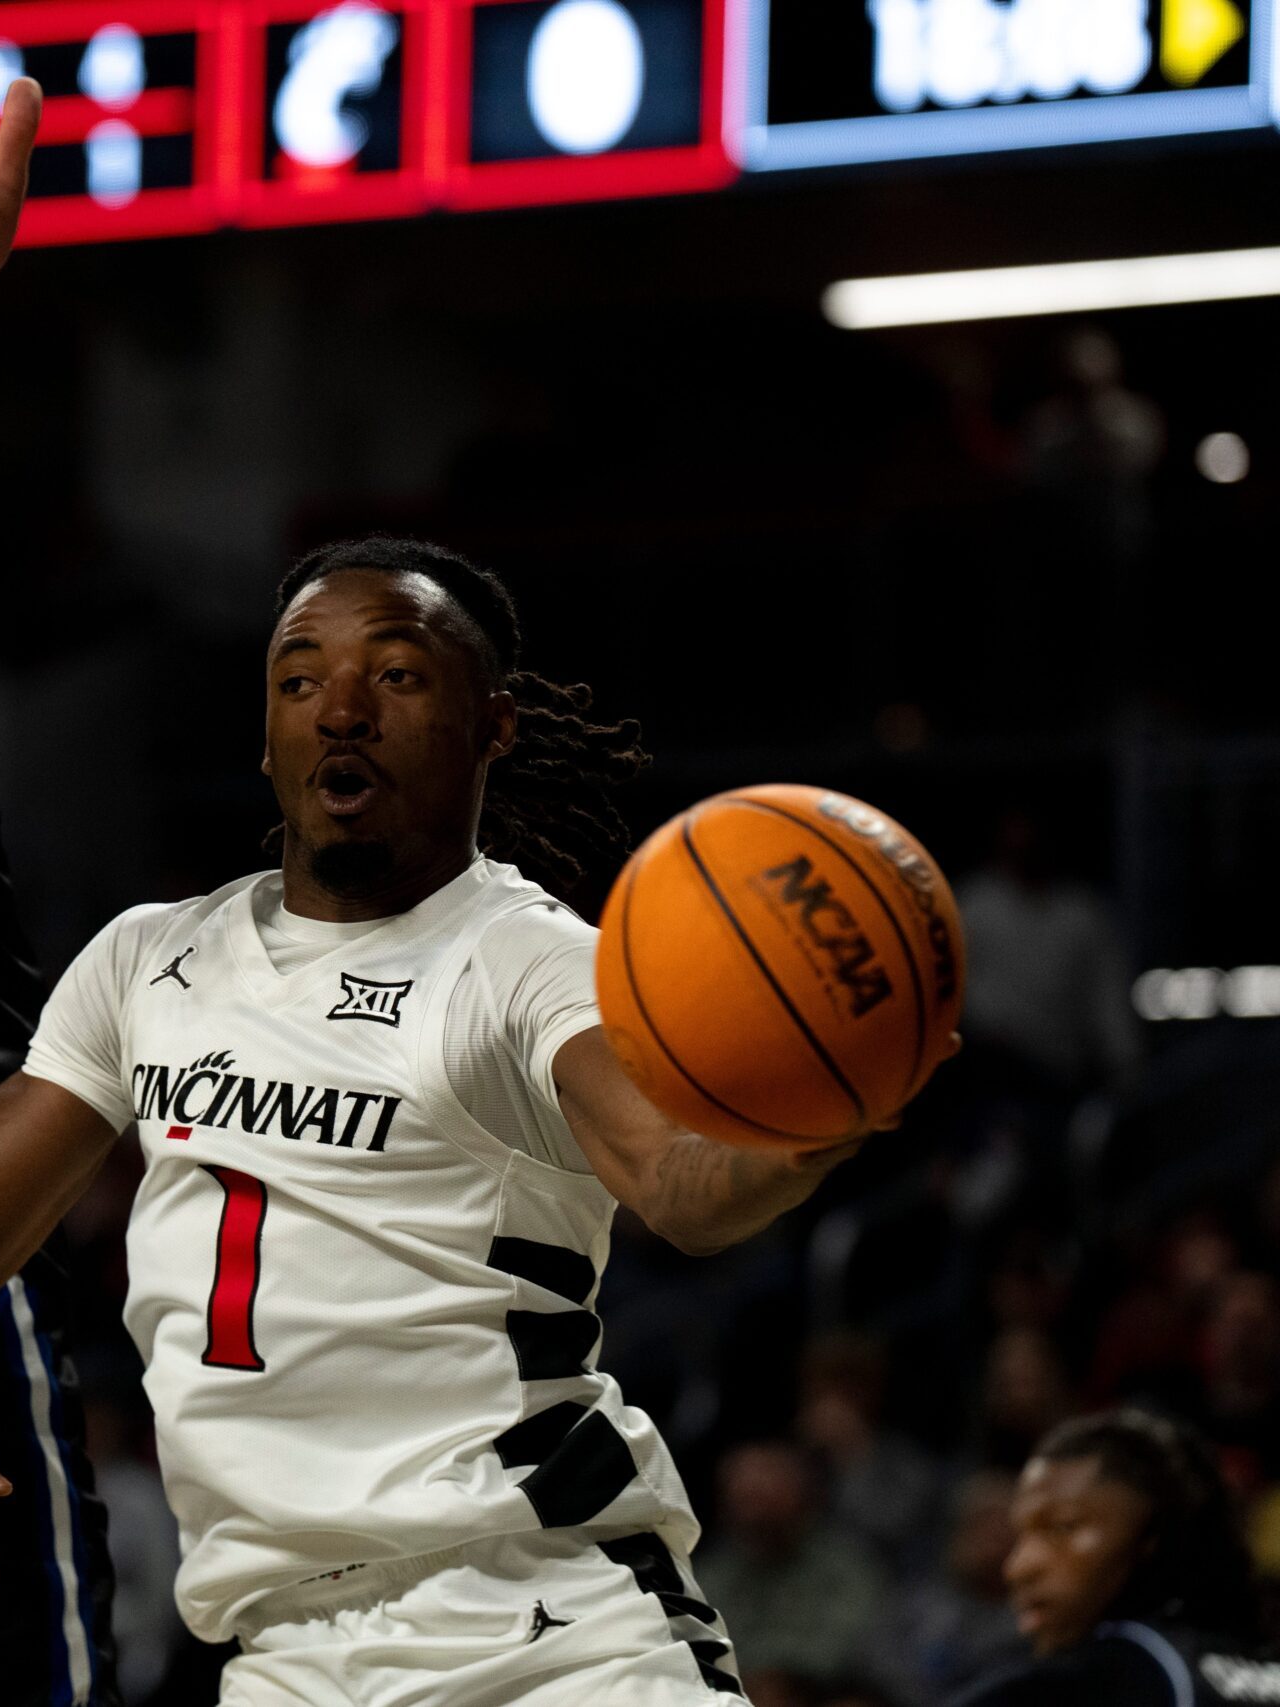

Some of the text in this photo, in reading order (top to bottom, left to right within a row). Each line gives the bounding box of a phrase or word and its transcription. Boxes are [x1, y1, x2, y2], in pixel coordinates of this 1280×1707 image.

[330, 975, 411, 1024] XII
[766, 854, 893, 1018] NCAA
[132, 1055, 402, 1152] CINCINNATI
[200, 1163, 267, 1372] 1
